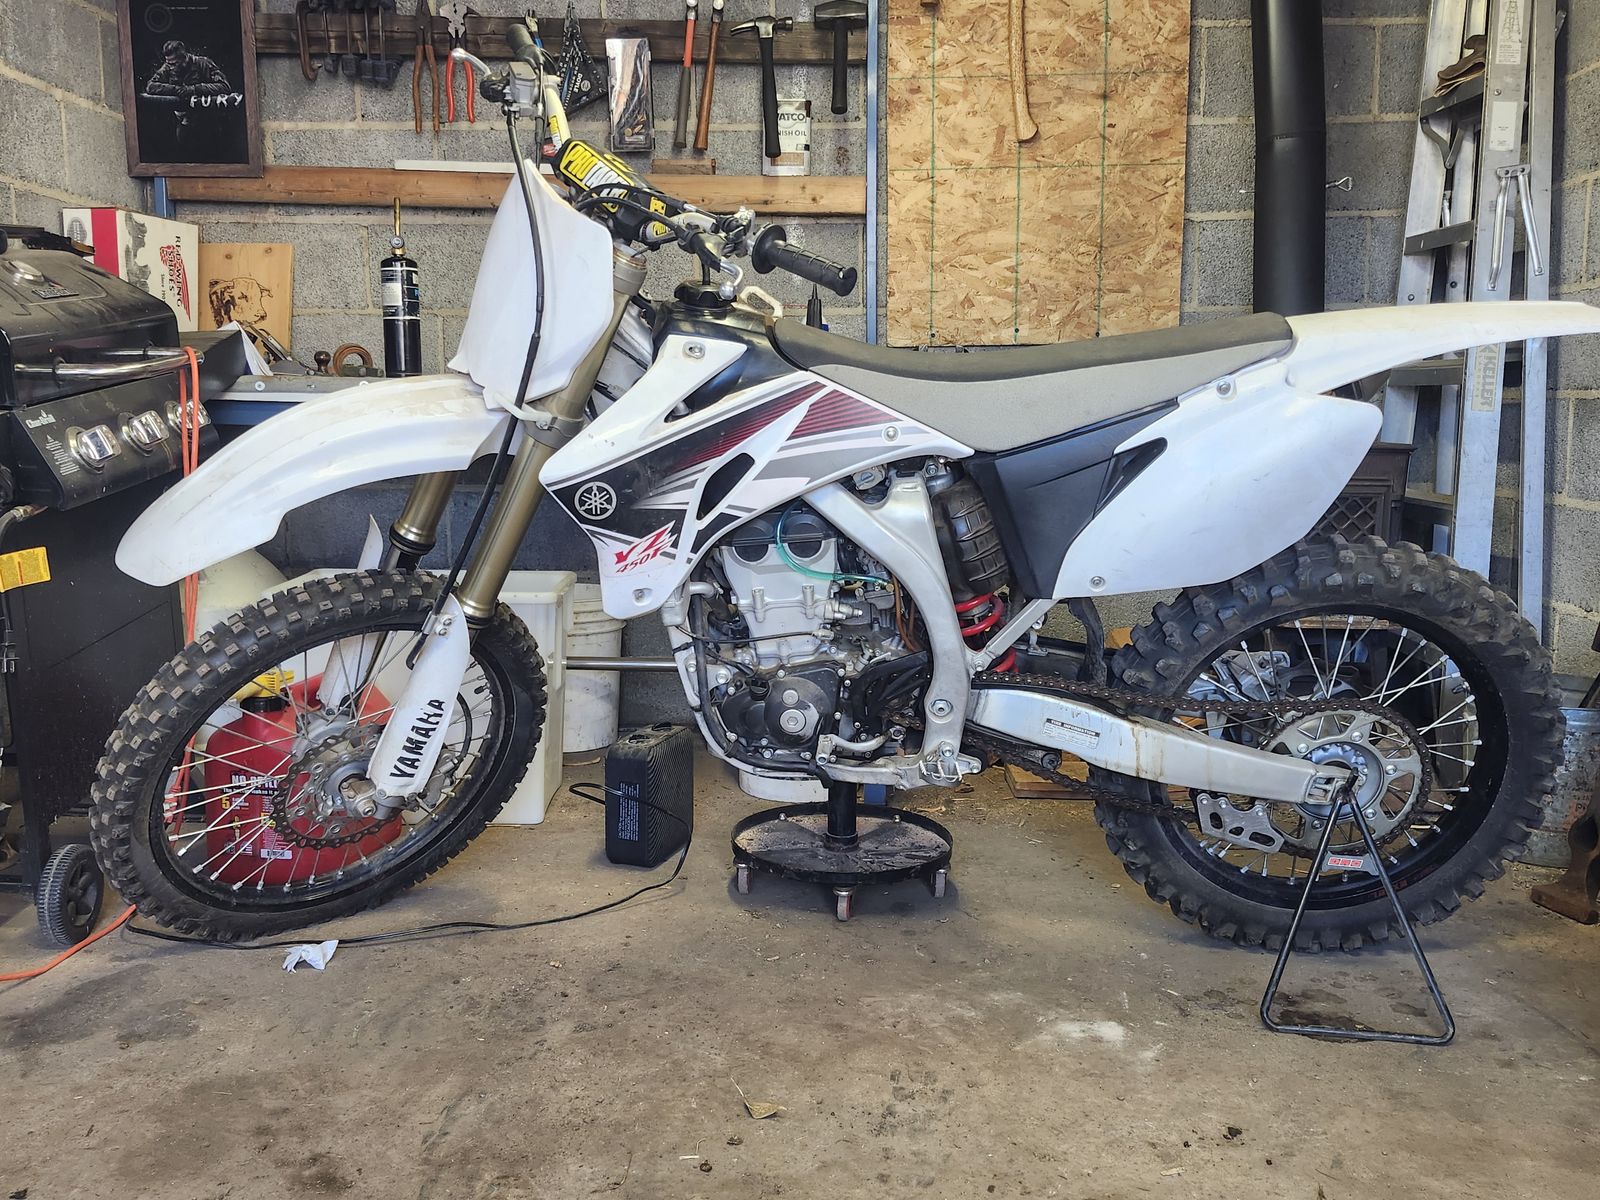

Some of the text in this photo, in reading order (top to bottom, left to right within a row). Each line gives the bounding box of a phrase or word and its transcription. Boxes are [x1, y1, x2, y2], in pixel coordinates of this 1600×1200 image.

[189, 92, 243, 108] FURY
[573, 73, 583, 93] DOYLE
[778, 112, 806, 121] ATCO
[167, 250, 175, 292] SHOES
[175, 235, 184, 308] RED WING
[1480, 354, 1498, 408] KELLER
[615, 526, 670, 565] YZ
[389, 699, 446, 778] YAMAHA
